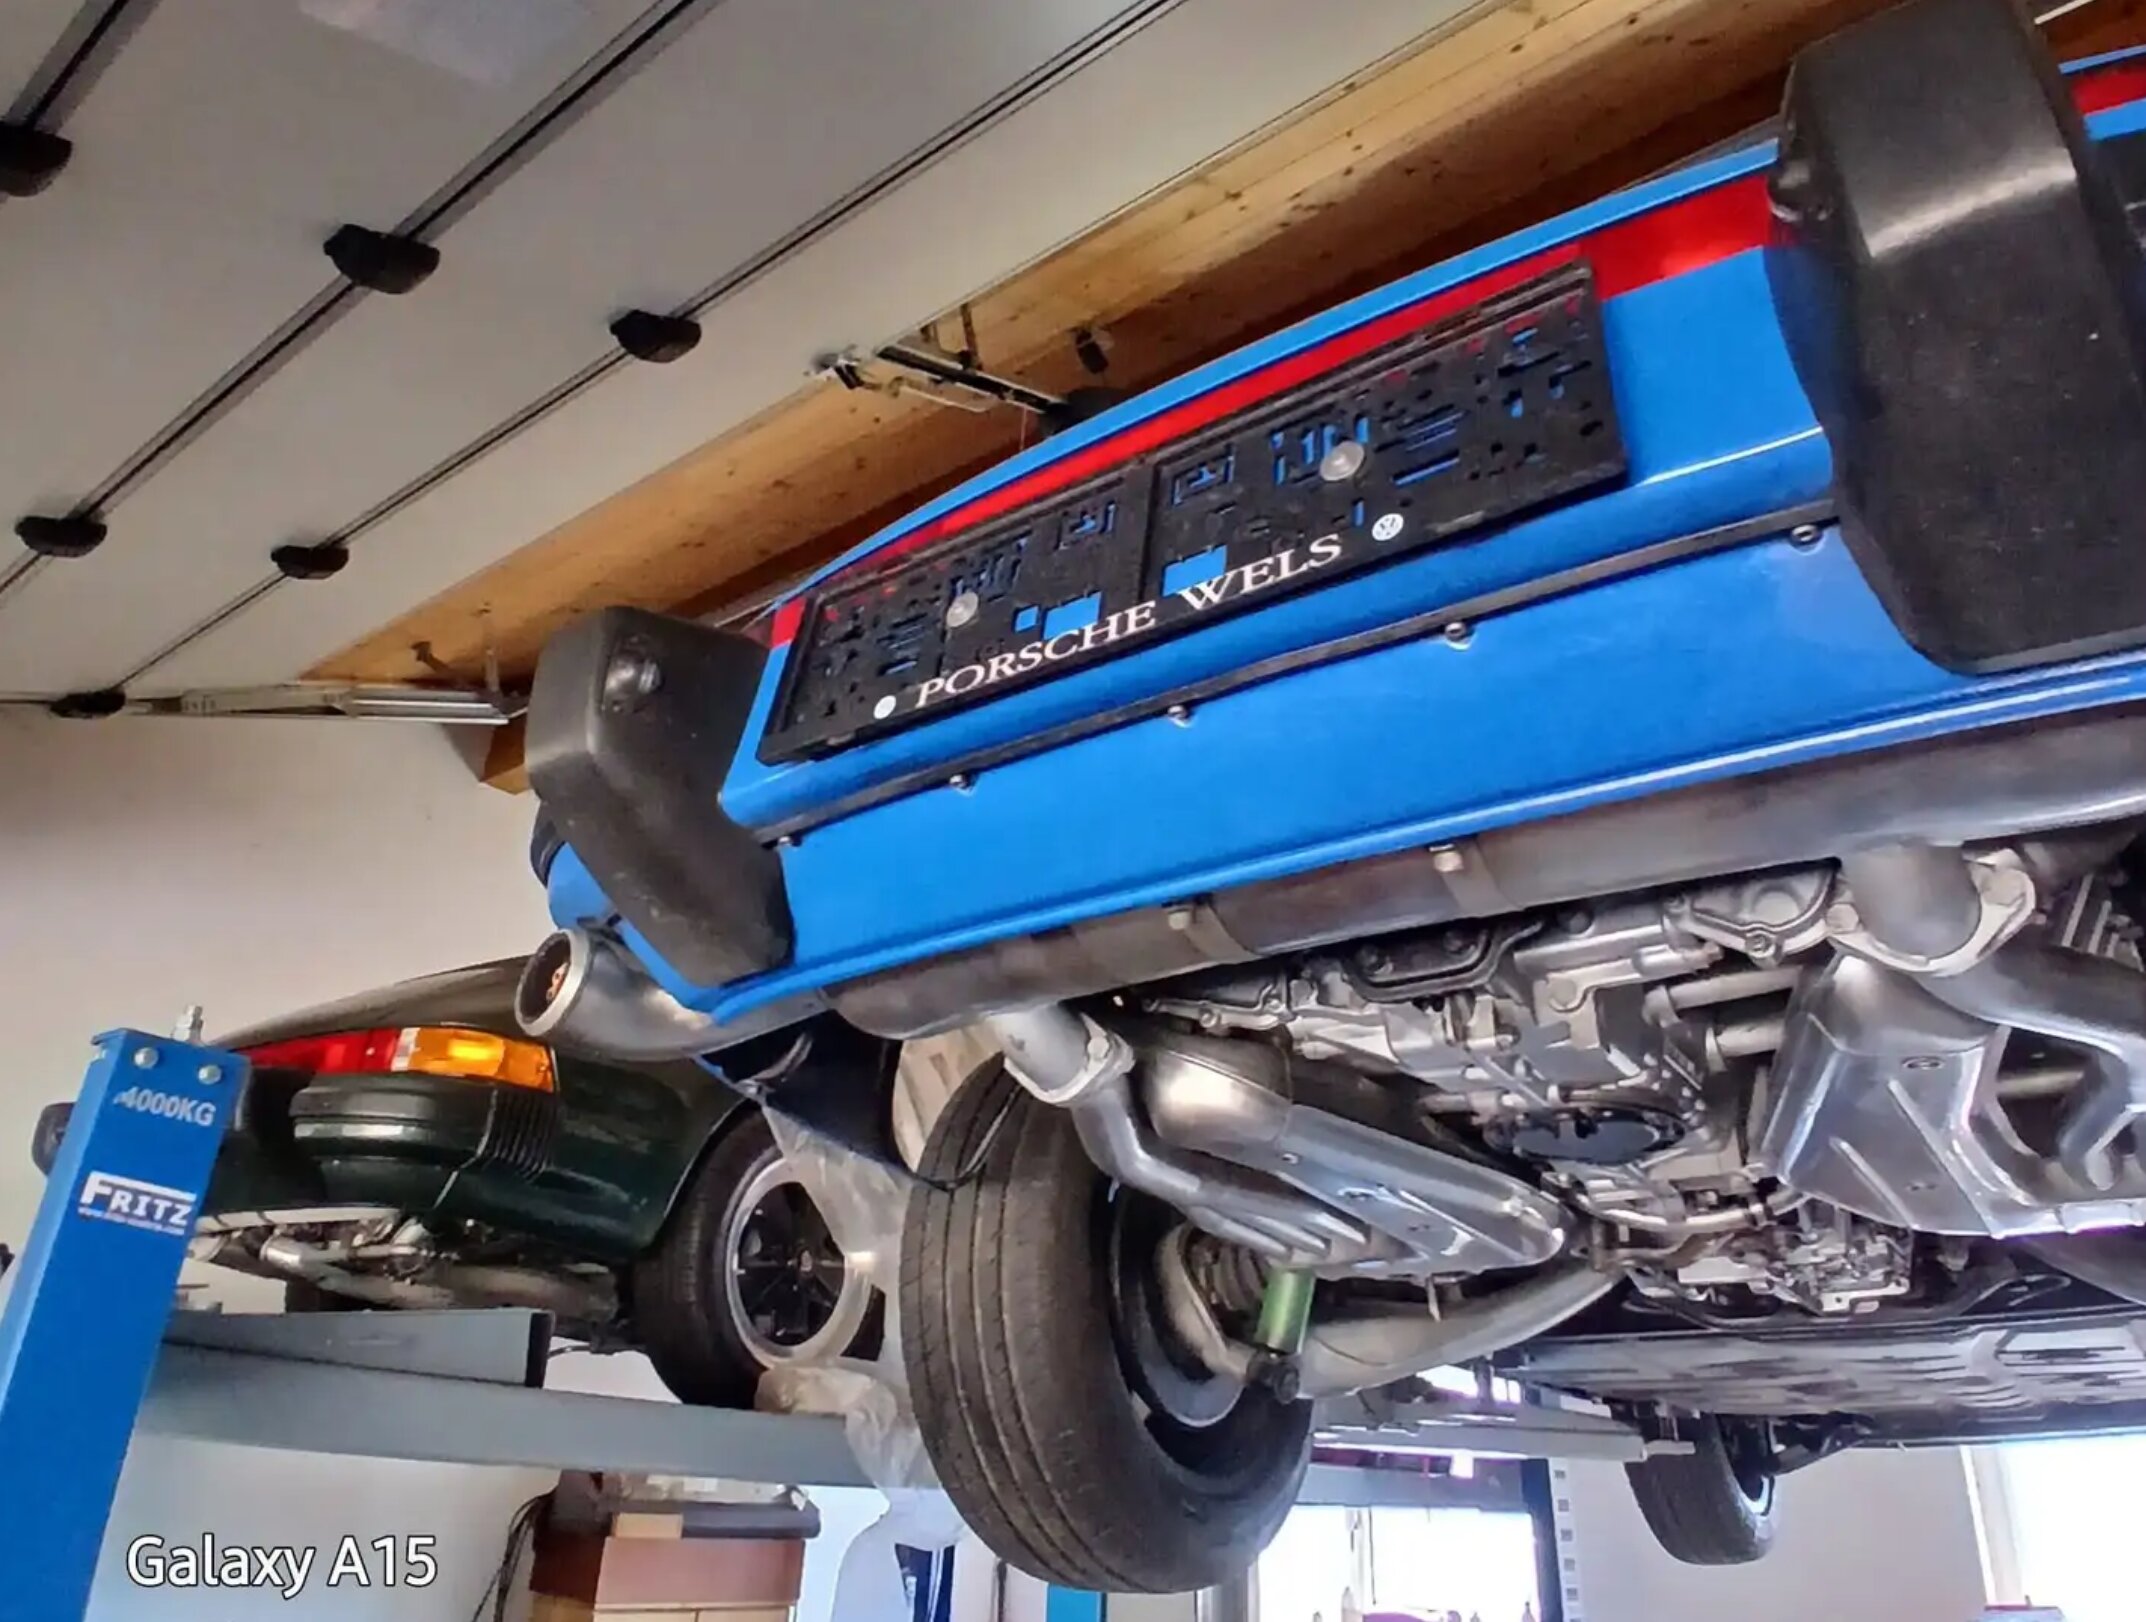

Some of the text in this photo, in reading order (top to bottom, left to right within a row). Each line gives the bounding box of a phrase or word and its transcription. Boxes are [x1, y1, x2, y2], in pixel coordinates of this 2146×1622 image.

[915, 533, 1342, 708] PORSCHE WELS
[80, 1170, 197, 1226] FRITZ
